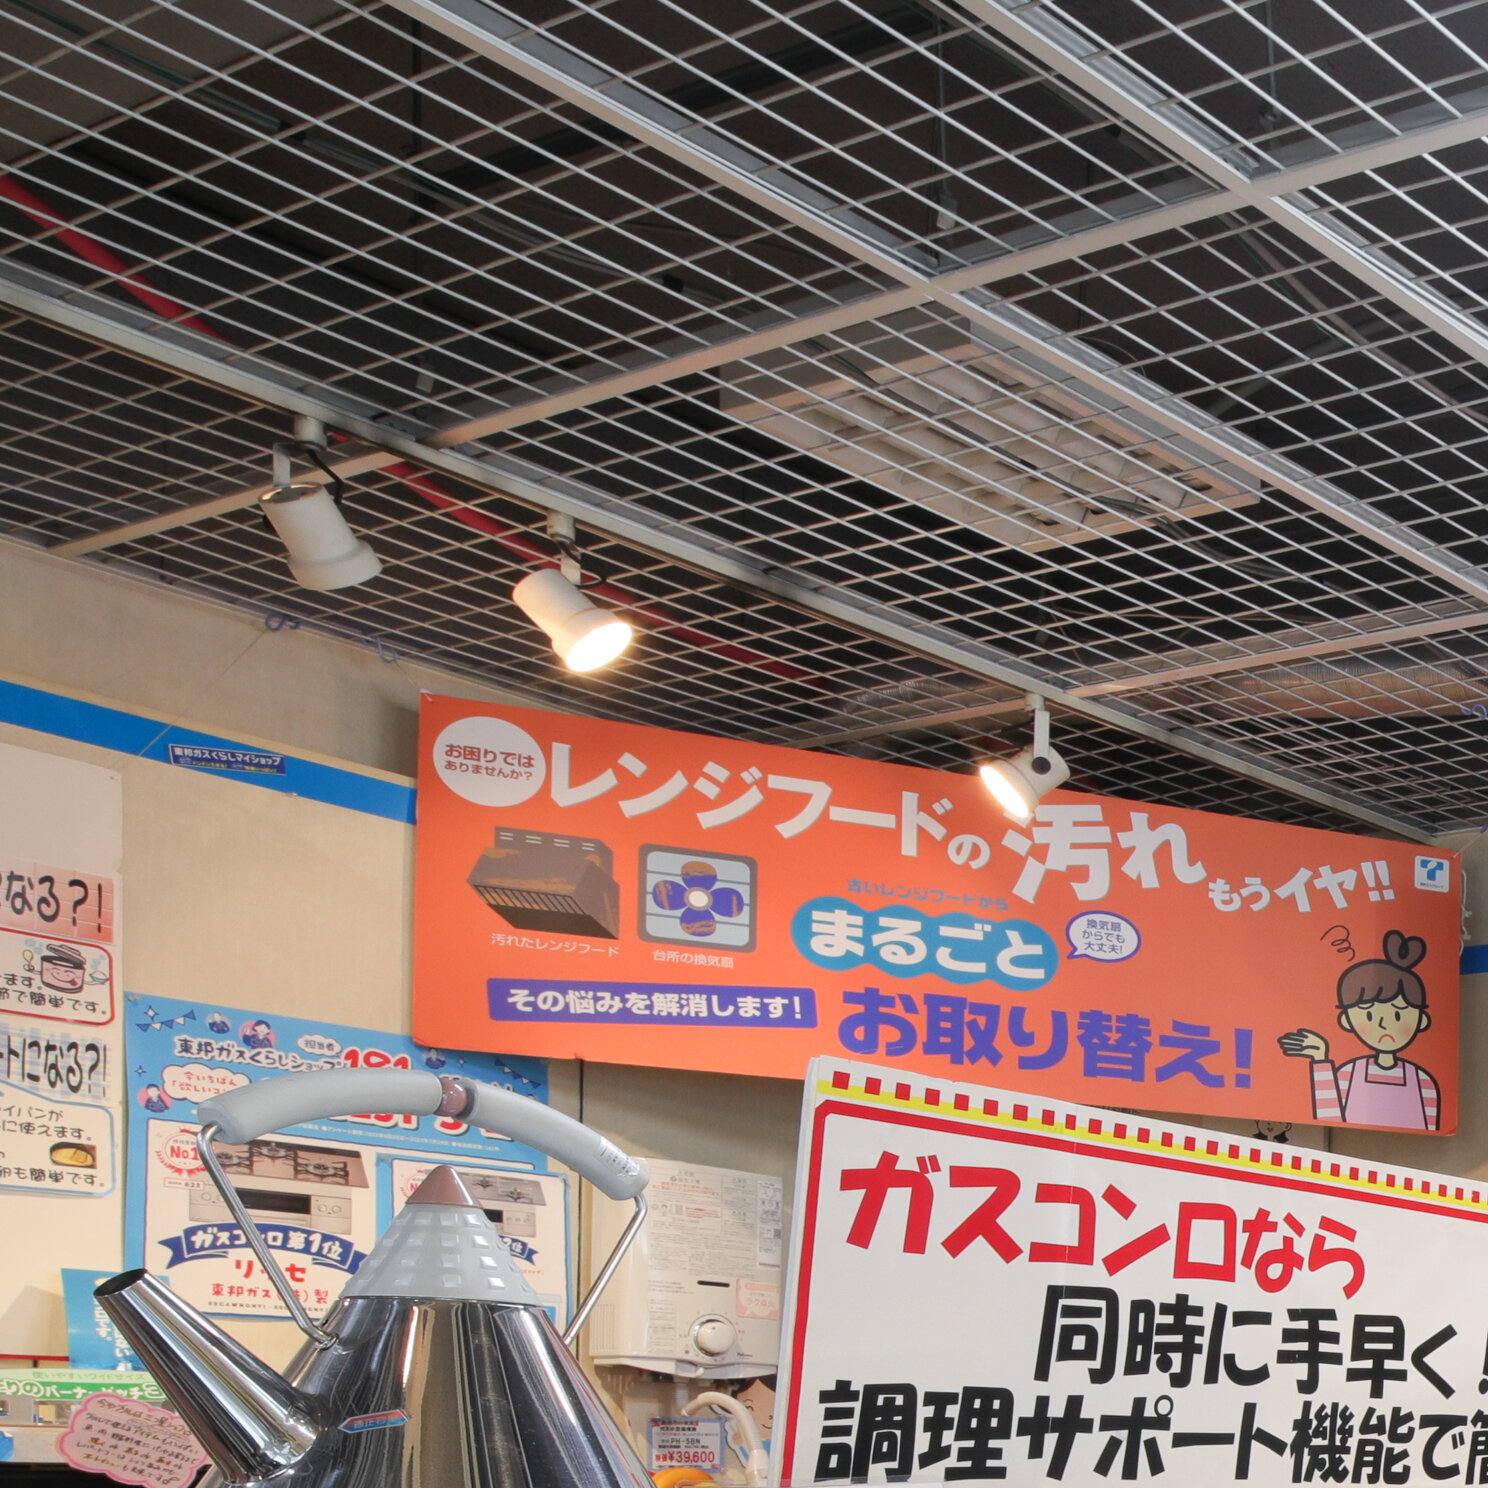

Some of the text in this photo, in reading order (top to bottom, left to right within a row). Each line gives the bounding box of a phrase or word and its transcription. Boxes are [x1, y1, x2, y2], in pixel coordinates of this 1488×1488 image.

[444, 742, 535, 769] お困りでは
[444, 760, 533, 782] ありませんか?
[847, 878, 1010, 911] 古いレンジフードから
[1081, 930, 1126, 944] からでも
[1085, 919, 1122, 933] 換気扇
[490, 933, 620, 957] 汚れたレンジフード
[811, 909, 1047, 980] まるごと
[652, 949, 735, 969] 台所の換気扇
[506, 986, 802, 1020] その悩みを解消します!
[304, 1038, 336, 1053] 担当者
[837, 987, 1252, 1089] お取り替え!
[838, 1150, 1366, 1298] ガスコンロなら
[190, 1228, 344, 1260] ガスコロ第1位
